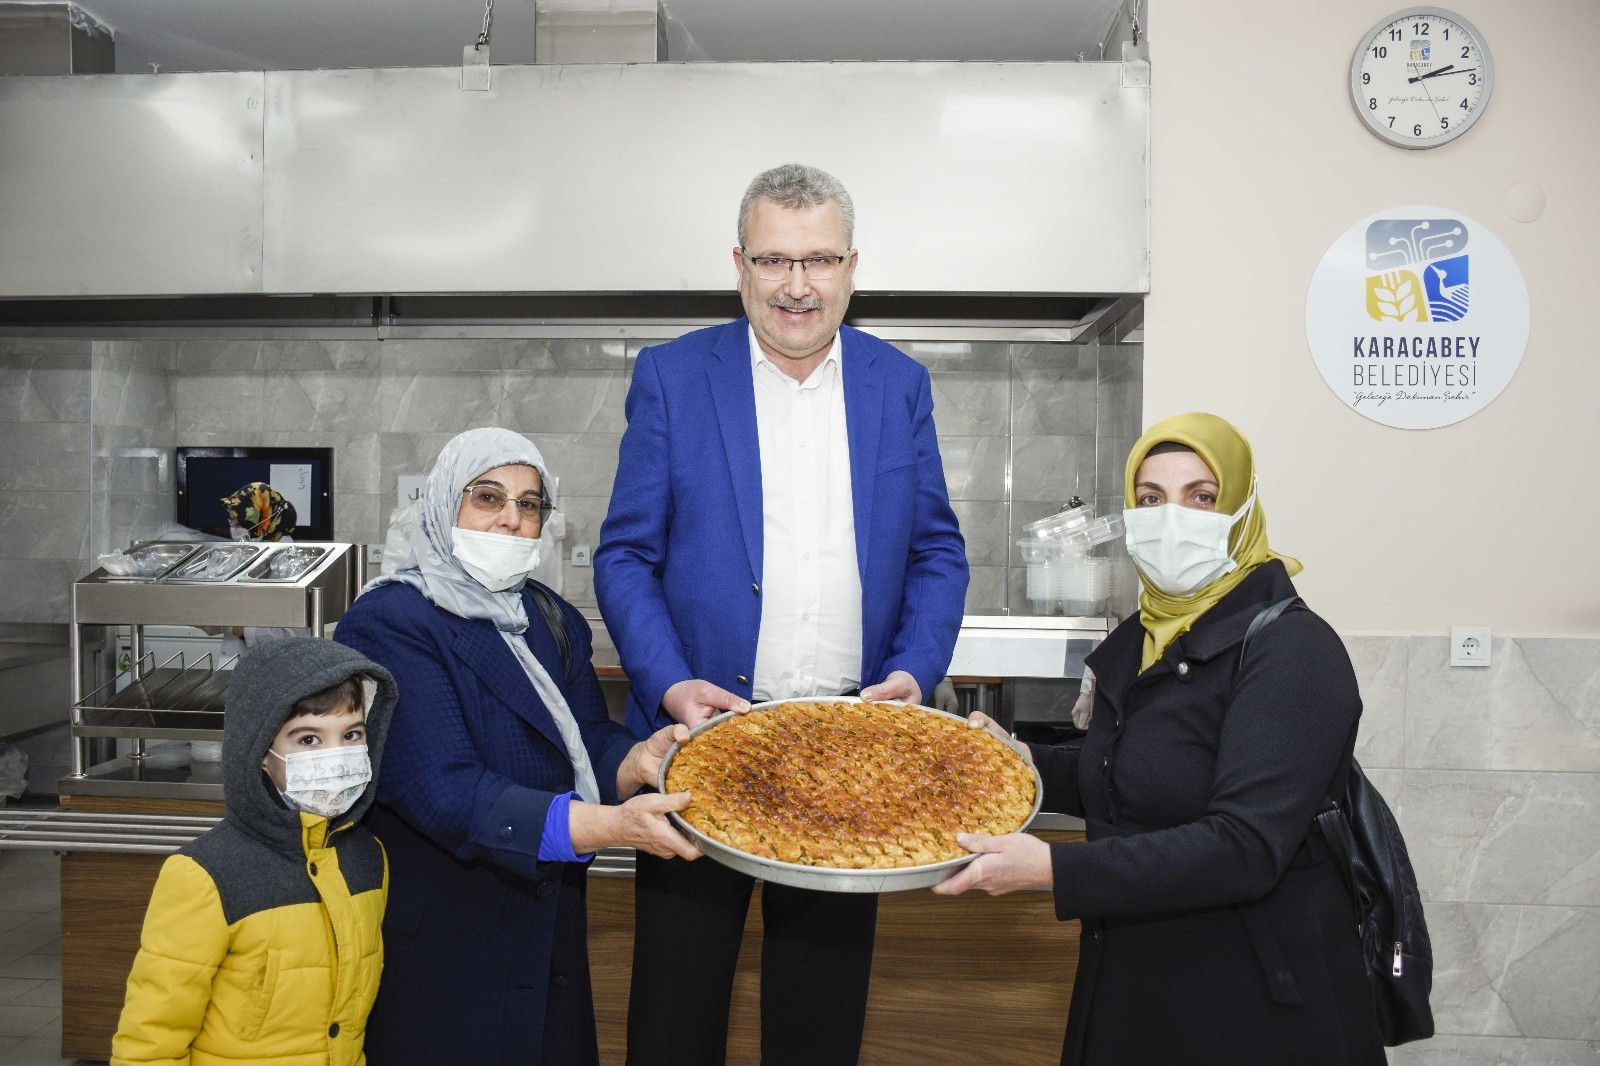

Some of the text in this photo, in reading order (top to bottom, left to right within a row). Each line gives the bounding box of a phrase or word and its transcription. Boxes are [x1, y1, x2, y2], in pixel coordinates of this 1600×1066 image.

[1388, 29, 1402, 41] 11
[1412, 22, 1430, 36] 12
[1443, 28, 1449, 41] 1
[1371, 46, 1387, 59] 10
[1461, 46, 1470, 59] 2
[1362, 72, 1371, 85] 9
[1468, 73, 1477, 86] 3
[1369, 97, 1377, 110] 8
[1460, 97, 1468, 110] 4
[1387, 116, 1396, 129] 7
[1440, 117, 1449, 129] 5
[1413, 124, 1422, 137] 6
[1353, 336, 1480, 358] KARACABEY
[1353, 360, 1476, 387] BELEDİYESİ
